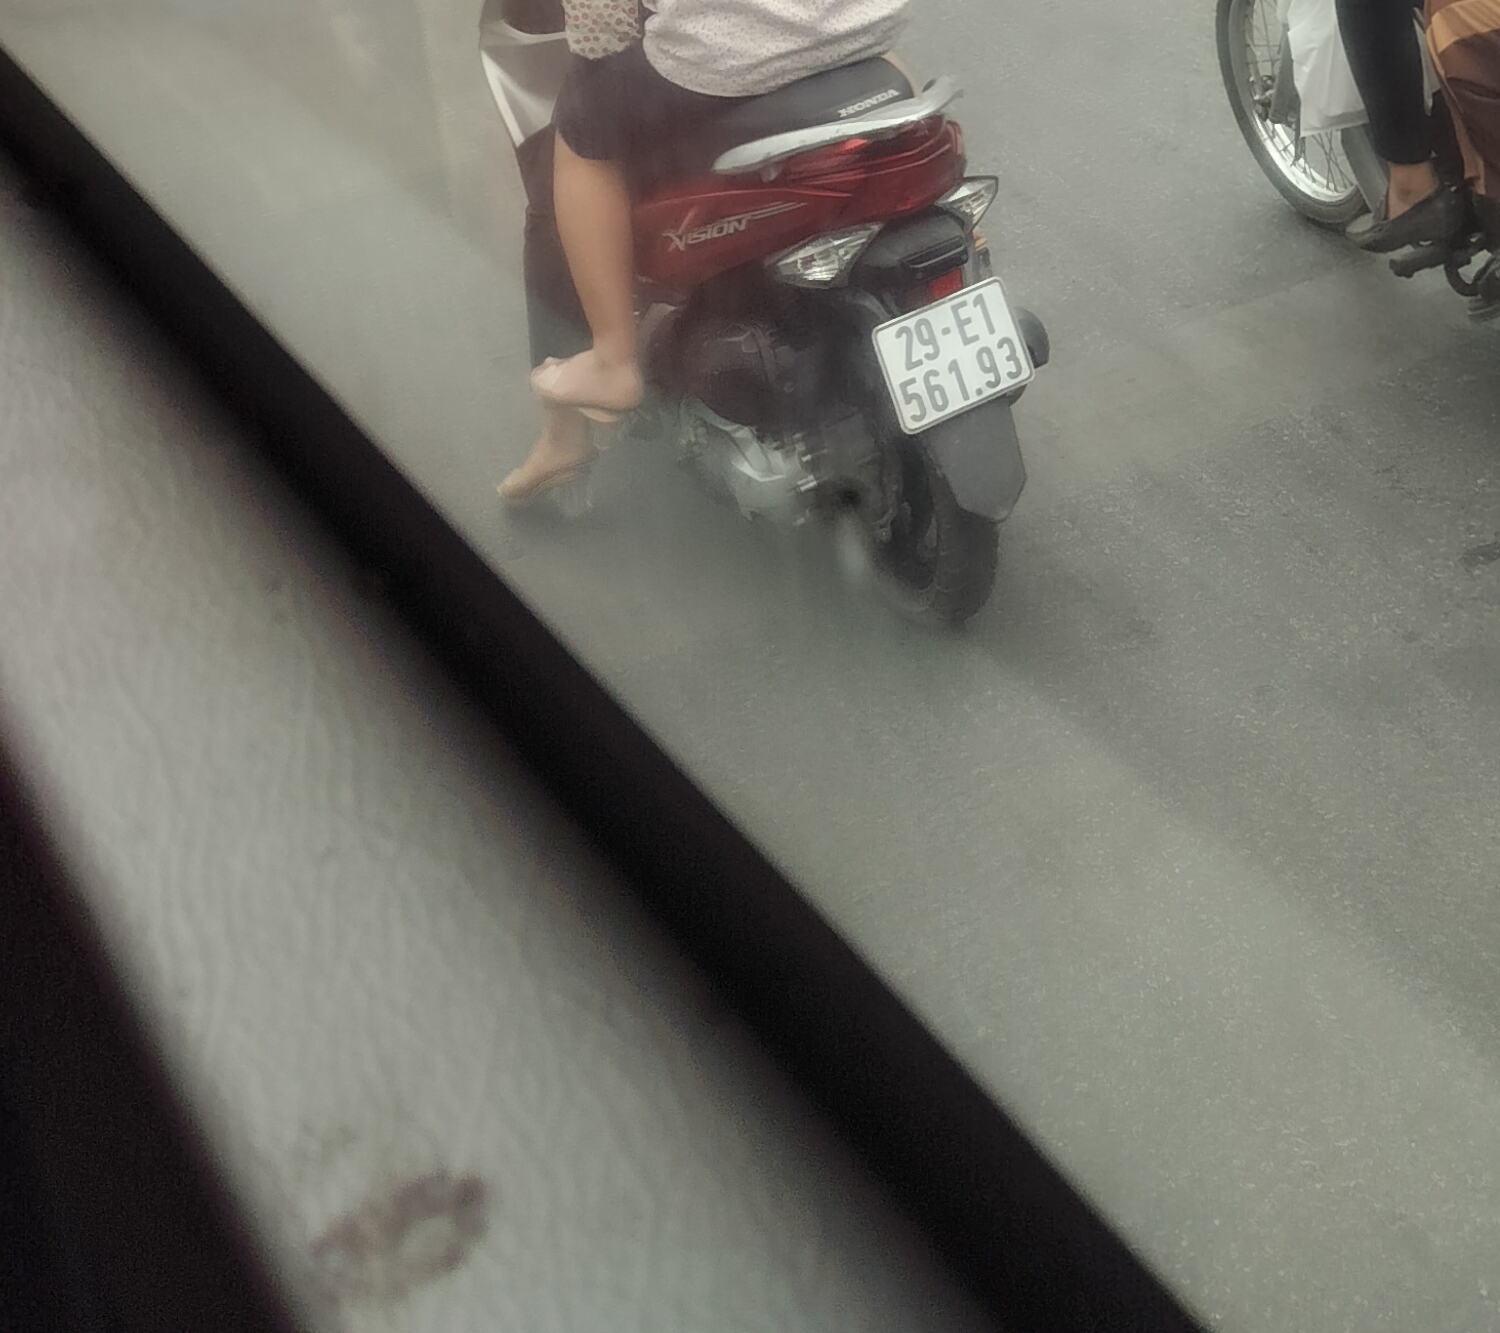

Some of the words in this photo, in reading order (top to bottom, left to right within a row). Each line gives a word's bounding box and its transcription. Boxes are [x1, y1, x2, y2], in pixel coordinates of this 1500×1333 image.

[838, 89, 900, 118] HONDA
[662, 208, 750, 252] VISION
[895, 291, 997, 372] 29-E1
[898, 336, 1022, 424] 561.93
